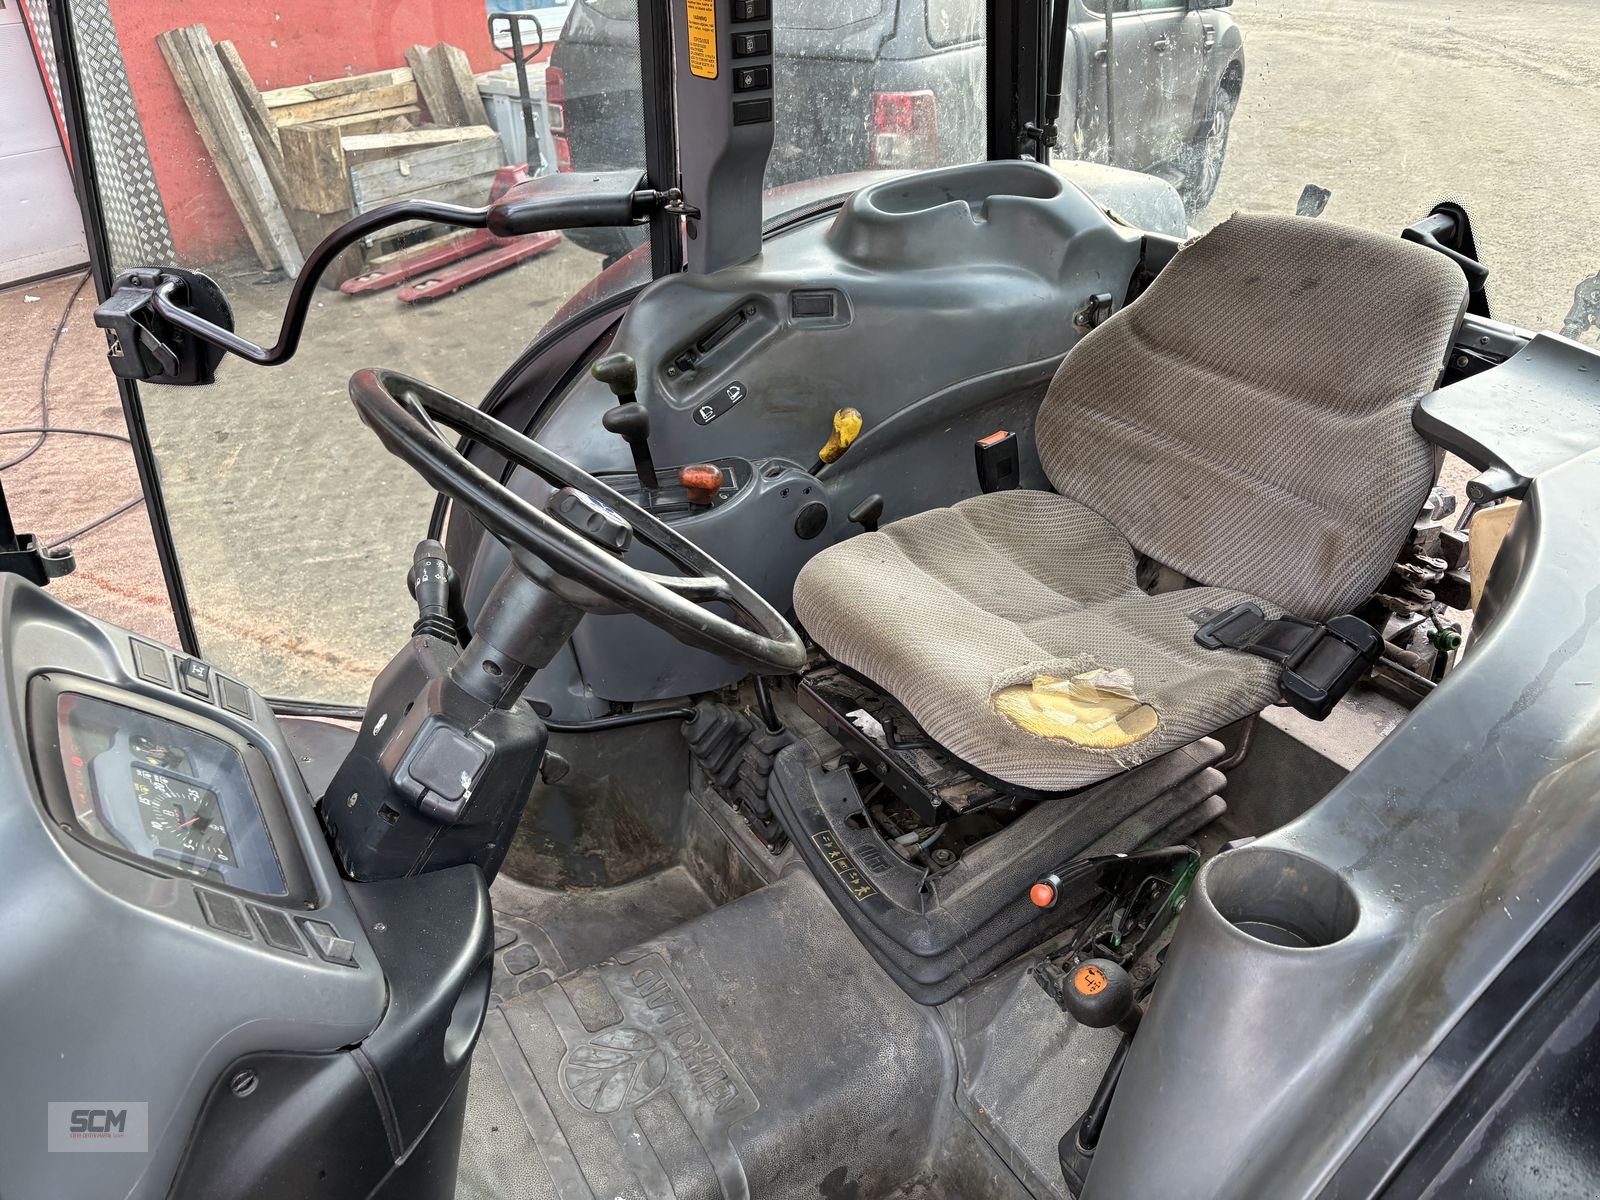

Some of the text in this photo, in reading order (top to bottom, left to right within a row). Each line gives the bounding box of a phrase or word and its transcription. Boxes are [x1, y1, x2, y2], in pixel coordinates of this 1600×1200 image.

[138, 795, 151, 806] 15
[151, 821, 164, 831] 10
[183, 843, 195, 851] 5
[631, 968, 746, 1118] NEW HOLLAND
